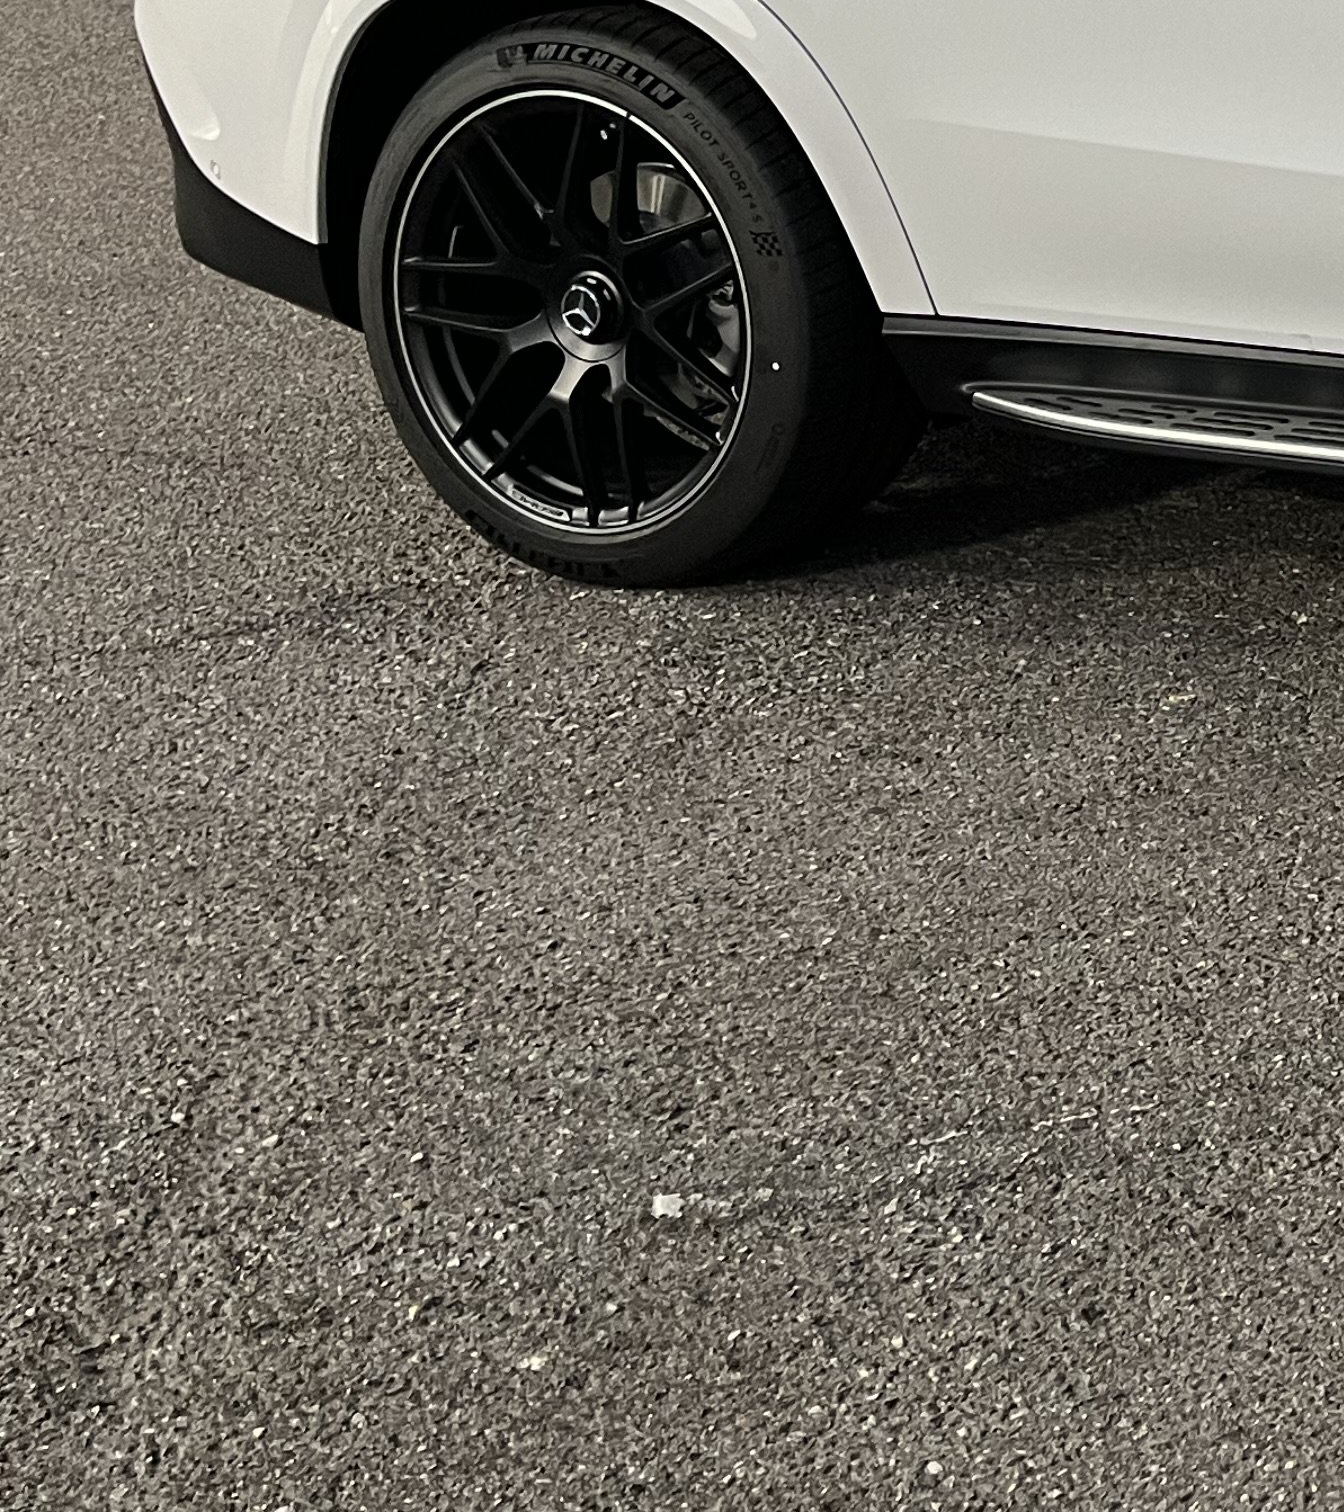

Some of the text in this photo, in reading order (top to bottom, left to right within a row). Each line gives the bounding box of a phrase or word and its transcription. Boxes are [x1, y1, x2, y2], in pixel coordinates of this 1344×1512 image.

[533, 43, 675, 103] MICHELIN
[683, 112, 719, 147] PILOT
[717, 152, 753, 199] SPORT
